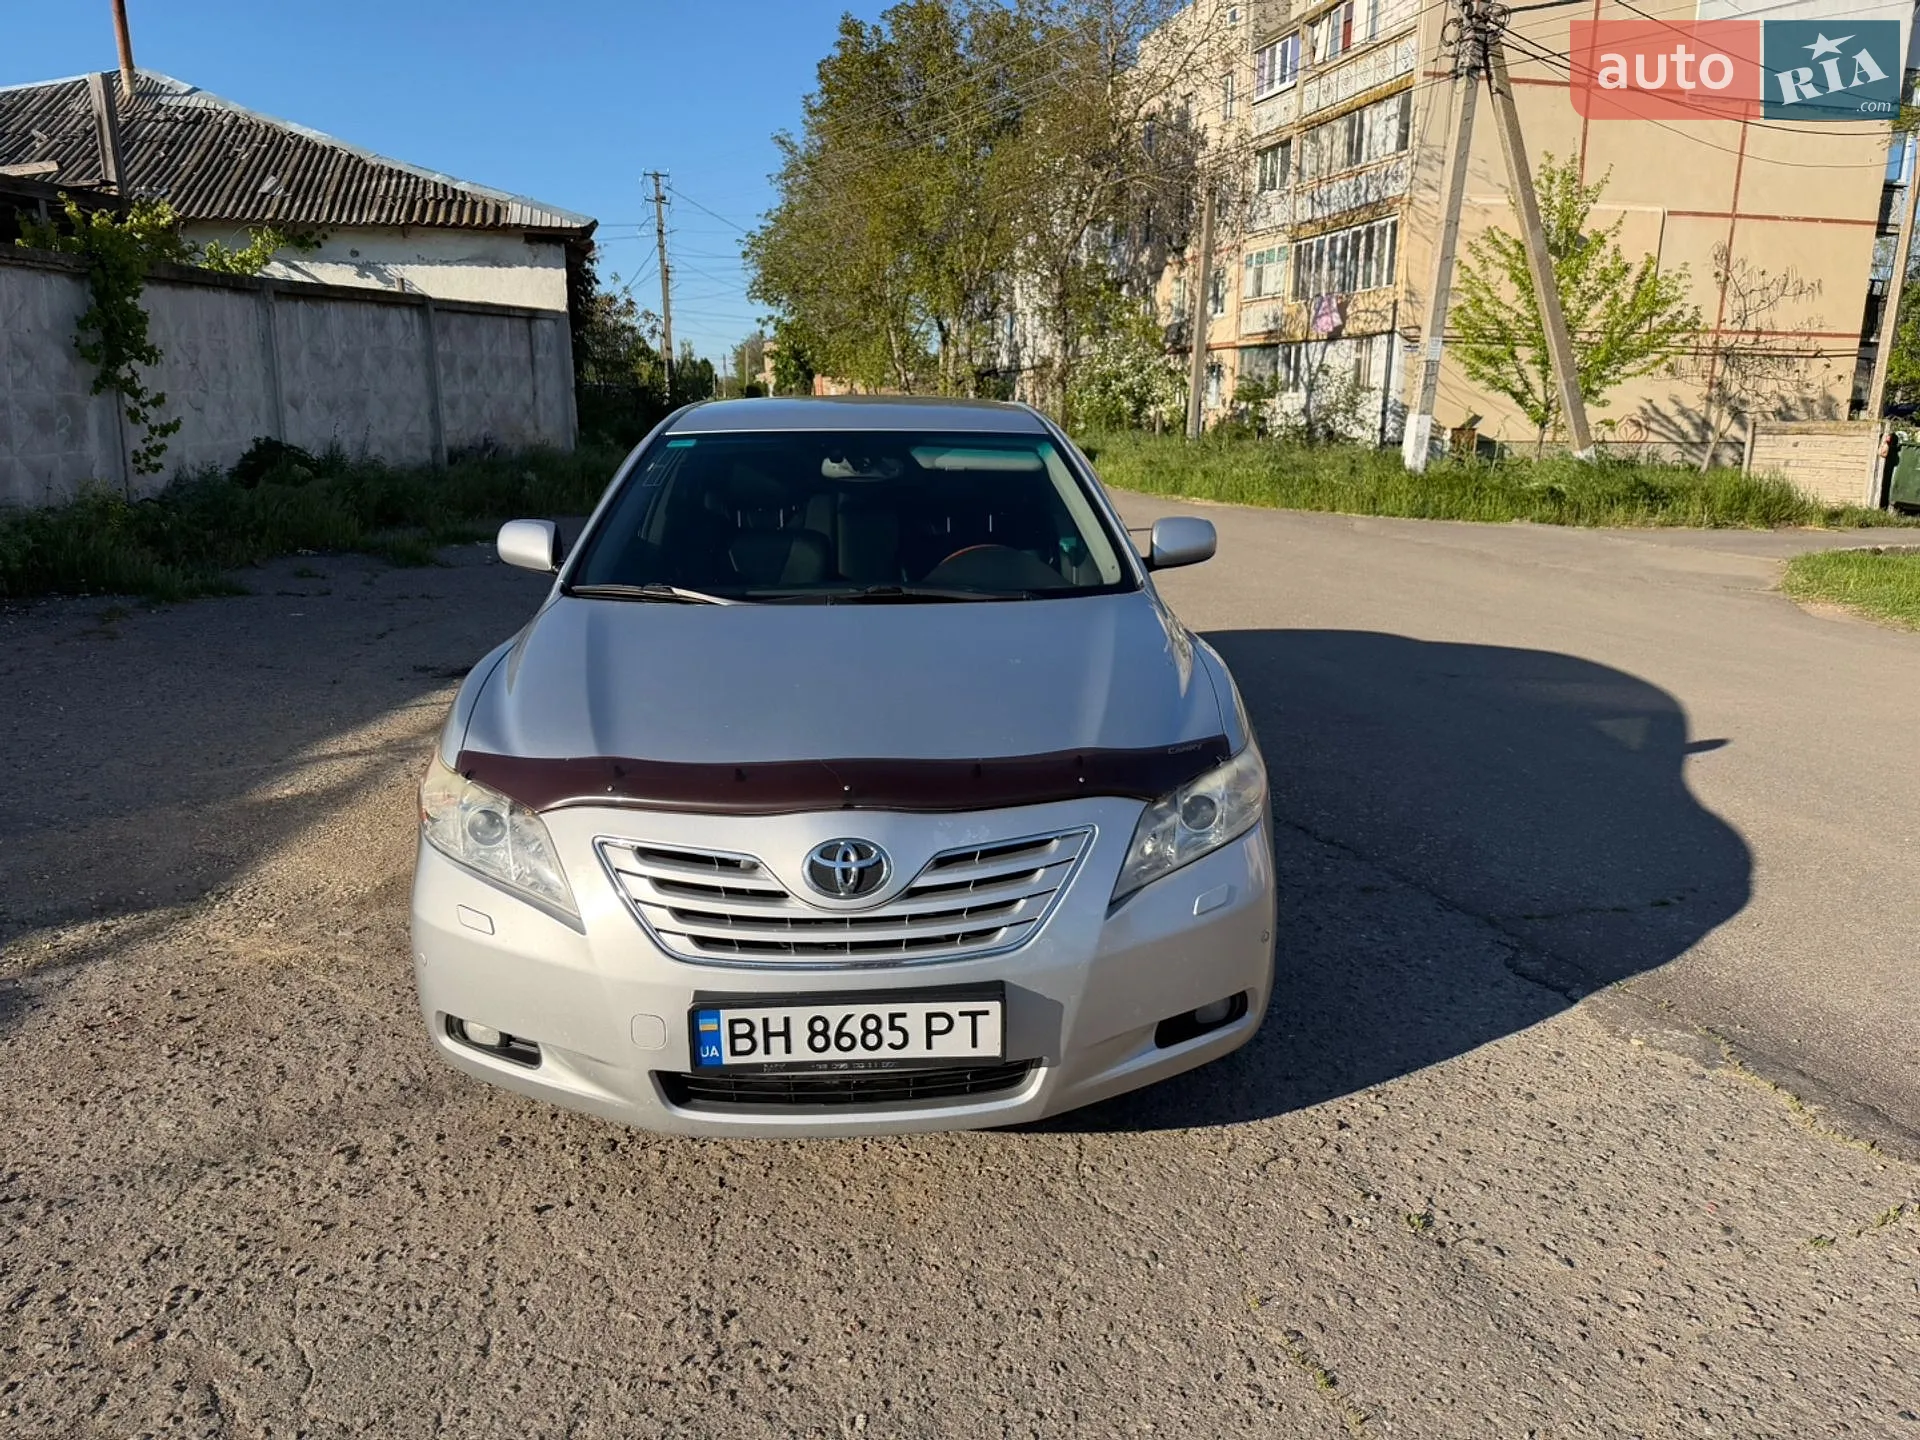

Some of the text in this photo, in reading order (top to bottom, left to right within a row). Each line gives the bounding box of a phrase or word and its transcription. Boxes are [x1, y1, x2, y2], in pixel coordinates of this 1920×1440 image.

[727, 1009, 991, 1057] BH 8685 PT
[700, 1045, 720, 1057] UA
